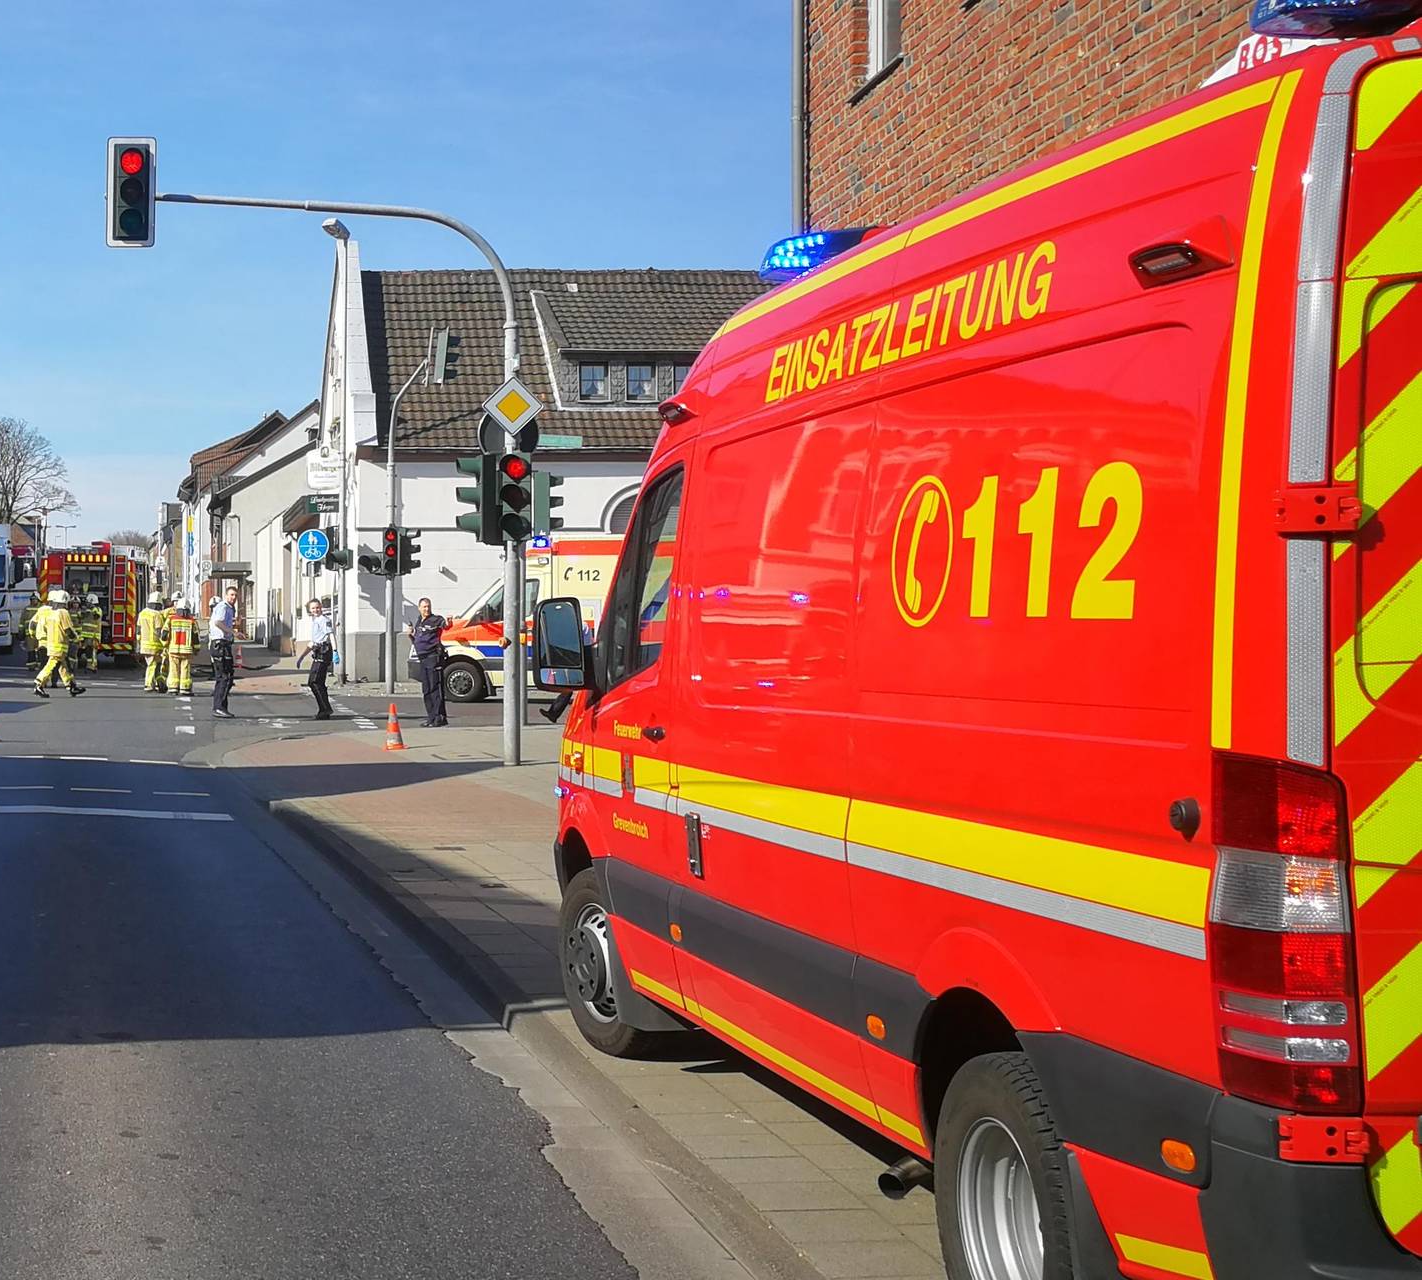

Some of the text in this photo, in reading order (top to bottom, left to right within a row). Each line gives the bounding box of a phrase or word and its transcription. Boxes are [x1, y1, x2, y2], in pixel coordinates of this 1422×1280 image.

[765, 241, 1056, 403] EINSATZLEITUNG
[962, 461, 1136, 620] 112
[578, 569, 600, 581] 112
[613, 719, 642, 740] Feuerwehr
[612, 811, 649, 840] Grevenbroich
